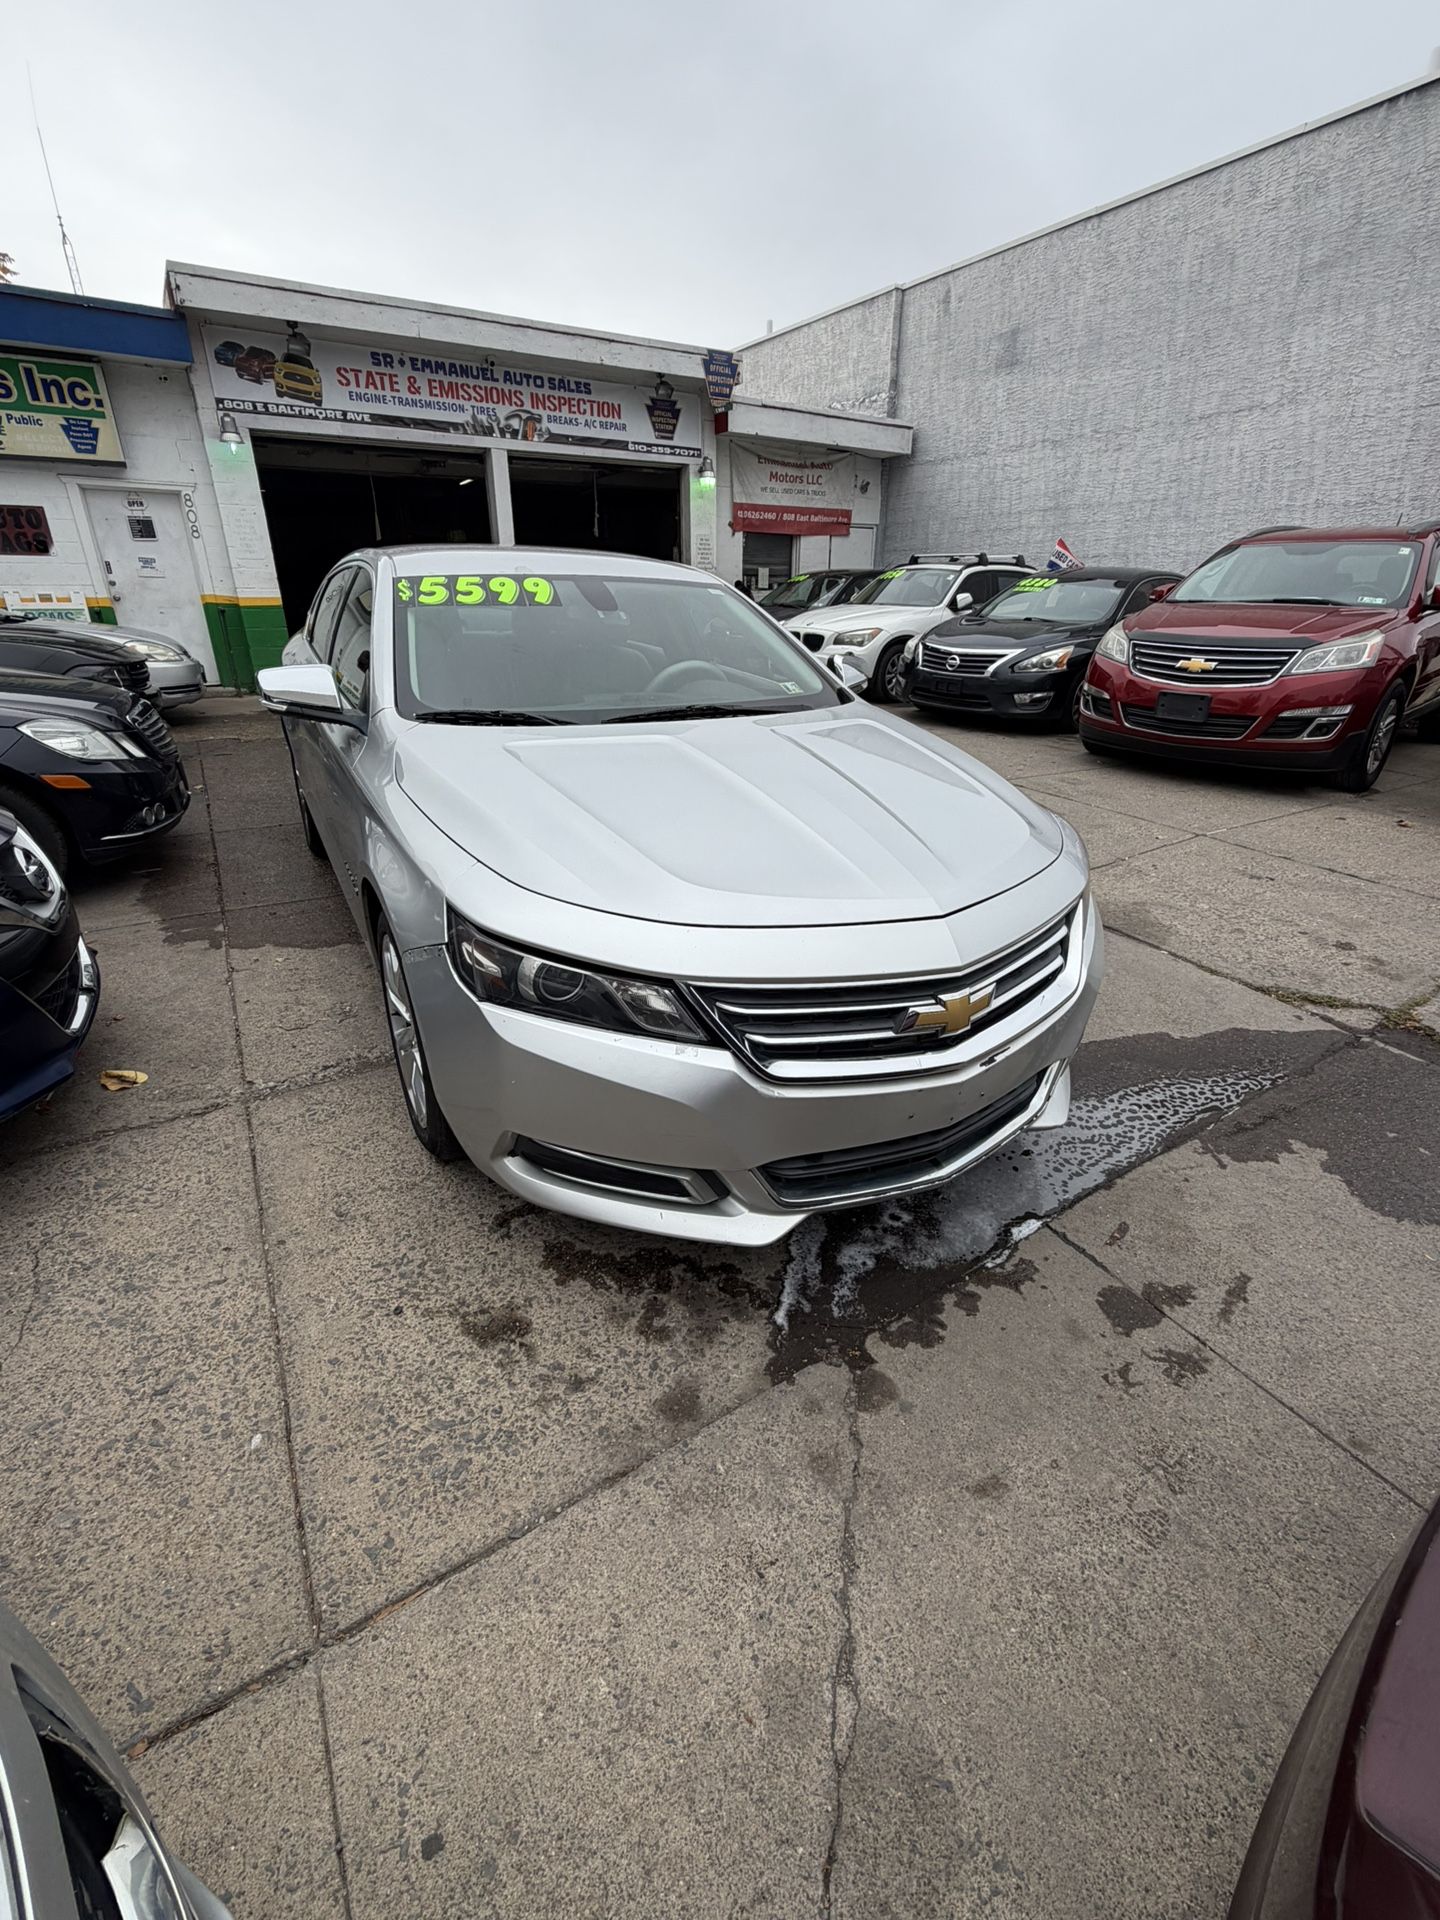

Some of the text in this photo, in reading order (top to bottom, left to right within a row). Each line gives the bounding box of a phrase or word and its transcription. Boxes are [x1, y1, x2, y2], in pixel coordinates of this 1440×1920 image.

[409, 356, 499, 382] EMMANUEL
[503, 370, 545, 388] AUTO
[547, 376, 592, 395] SALES
[710, 364, 731, 374] OFFICIAL
[23, 367, 104, 408] Inc.
[336, 366, 622, 420] STATE & EMISSIONS INSPECTION
[256, 402, 265, 411] E
[346, 412, 372, 422] AVE
[470, 405, 497, 417] TIRES
[5, 413, 43, 426] Public
[584, 419, 600, 430] A/C
[600, 420, 627, 432] REPAIR
[769, 471, 823, 485] Motors LLC
[794, 488, 806, 496] CARS
[127, 500, 144, 508] OPEN
[783, 513, 795, 521] 808
[796, 514, 809, 522] East
[810, 515, 838, 524] Baltimore
